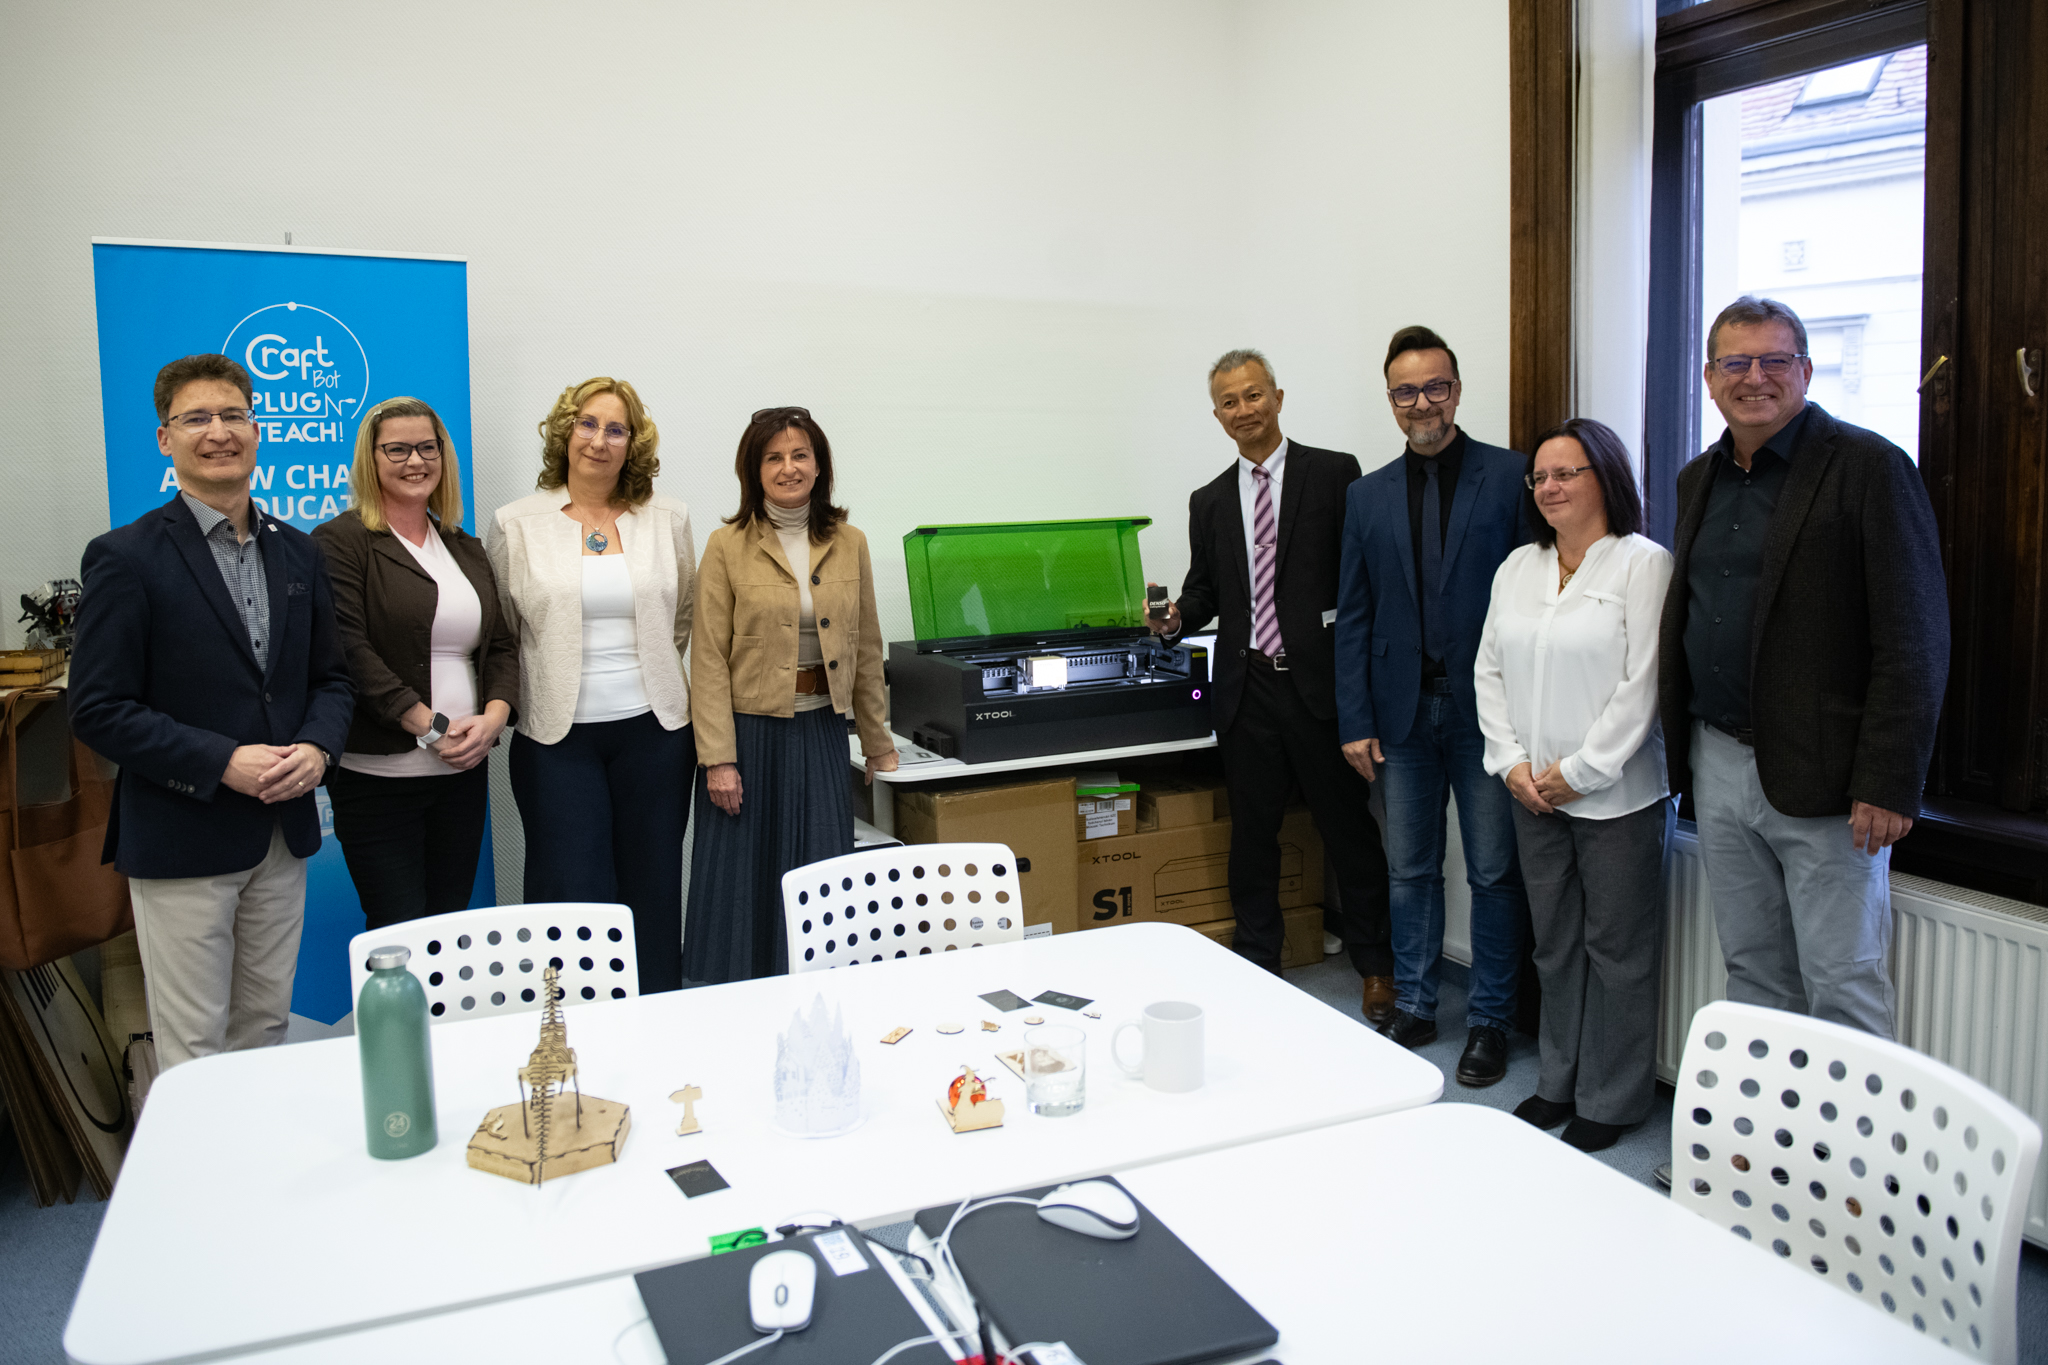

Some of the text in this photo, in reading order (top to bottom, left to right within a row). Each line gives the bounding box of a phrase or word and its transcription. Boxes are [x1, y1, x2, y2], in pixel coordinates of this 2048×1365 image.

[245, 333, 335, 380] Craft
[313, 369, 341, 389] Bot
[259, 421, 344, 442] TEACH!
[159, 466, 182, 492] A
[975, 710, 1016, 721] XTOOL
[1092, 851, 1141, 865] XTOOL
[1092, 886, 1132, 921] S1
[389, 1116, 405, 1129] 24
